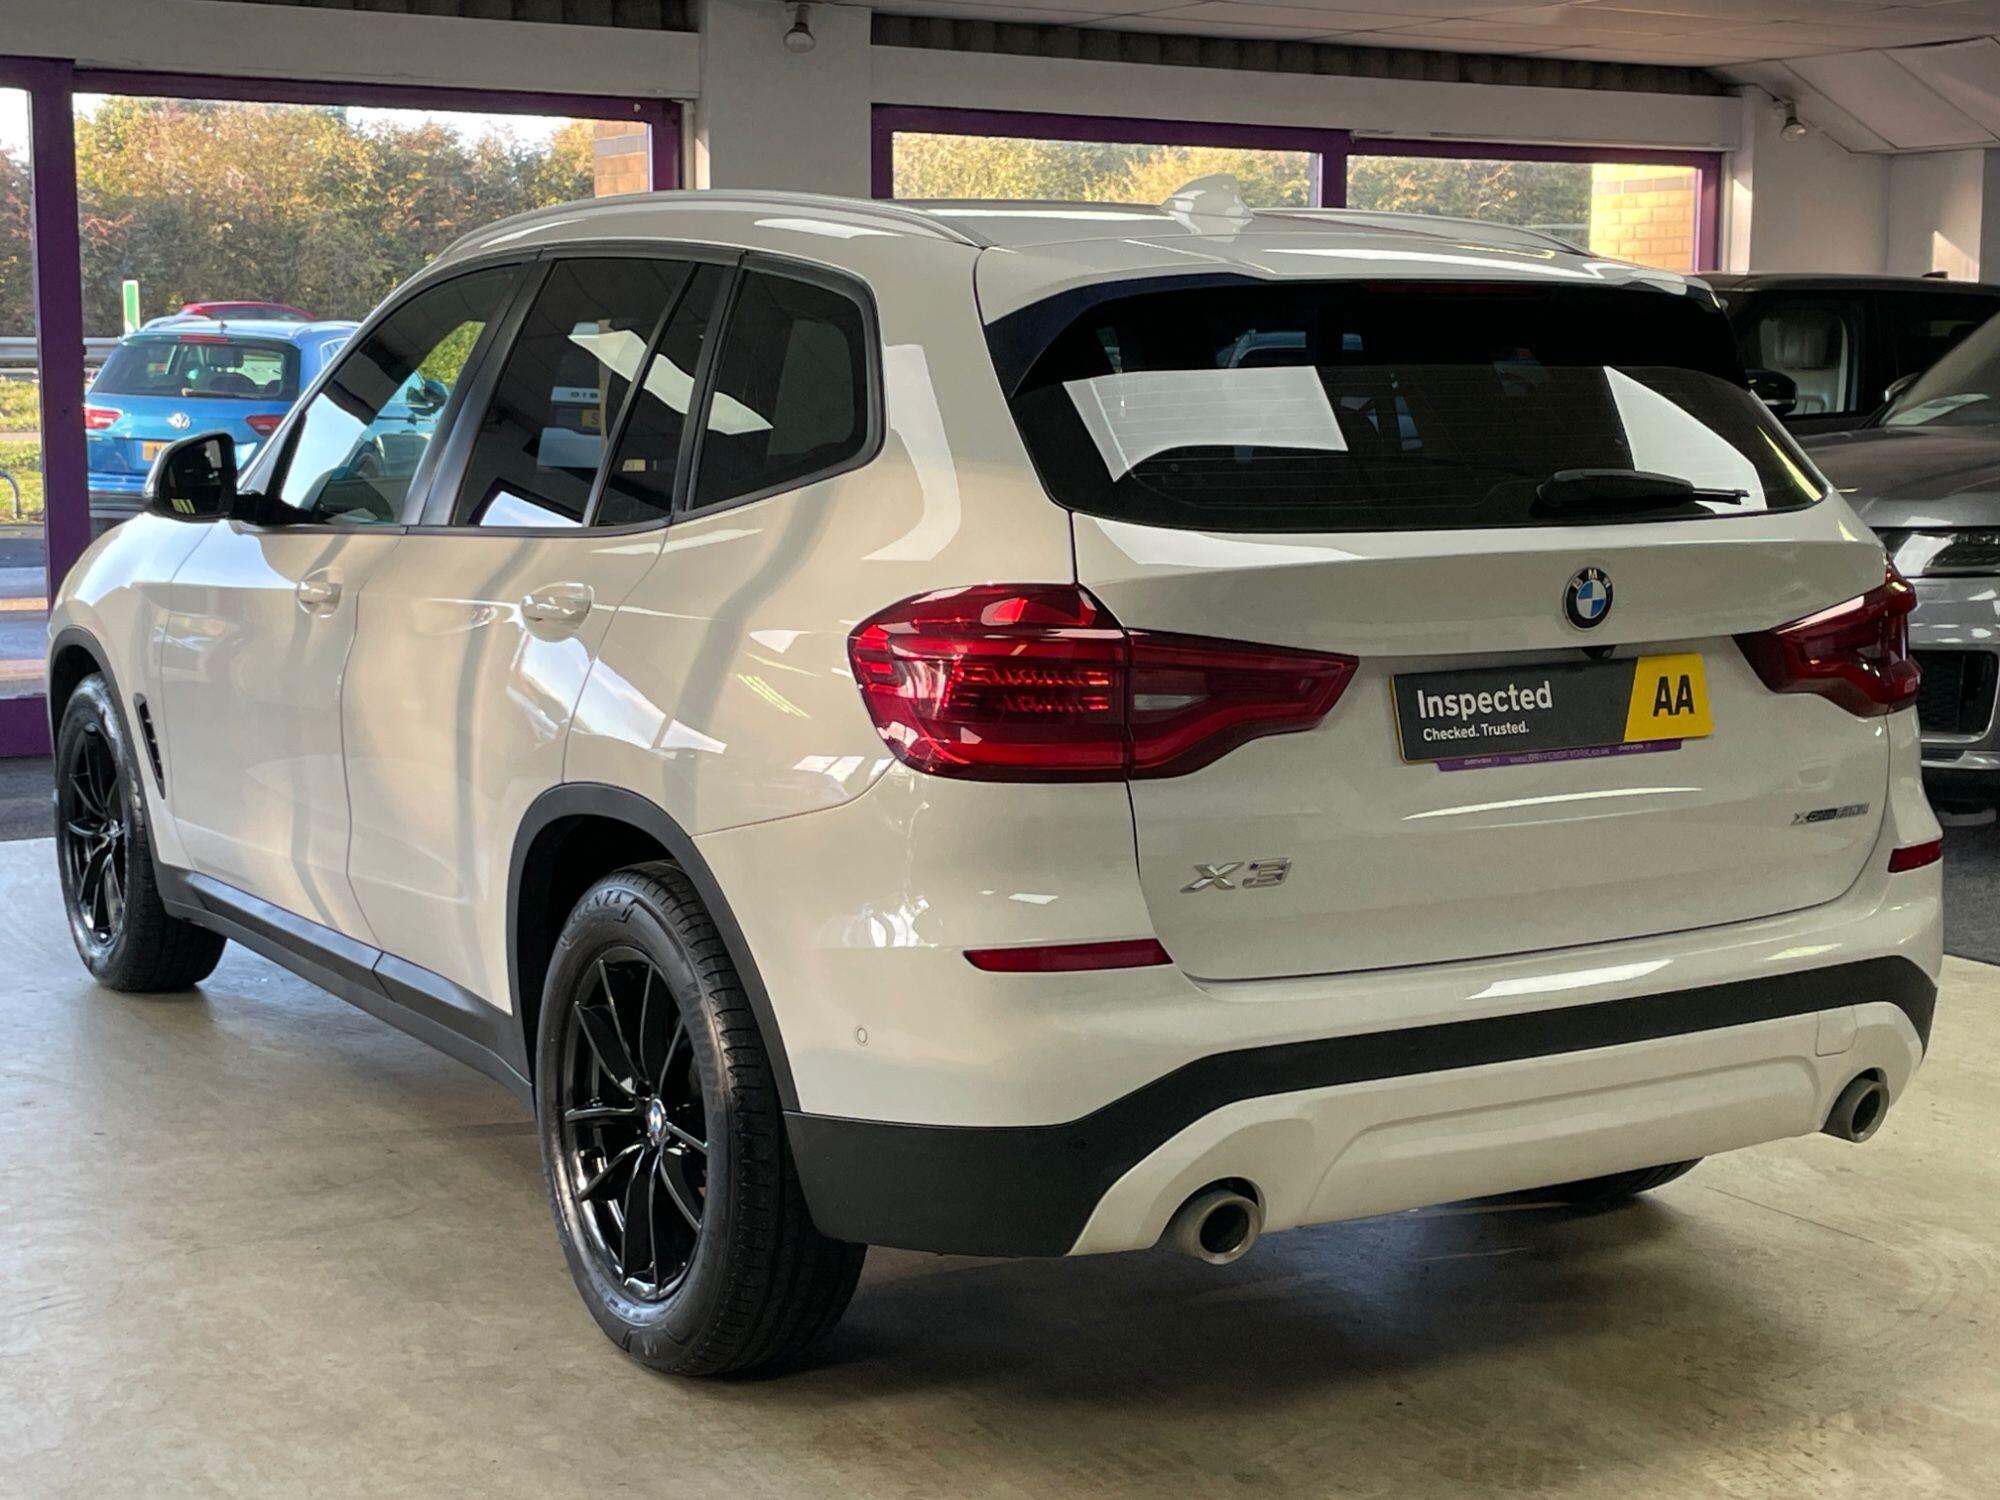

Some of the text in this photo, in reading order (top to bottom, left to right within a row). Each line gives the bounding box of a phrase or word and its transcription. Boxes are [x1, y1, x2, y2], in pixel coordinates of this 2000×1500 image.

[1416, 680, 1553, 721] Inspected
[1653, 674, 1696, 717] AA
[1422, 720, 1530, 742] Checked. Trusted.
[1179, 857, 1293, 894] X3
